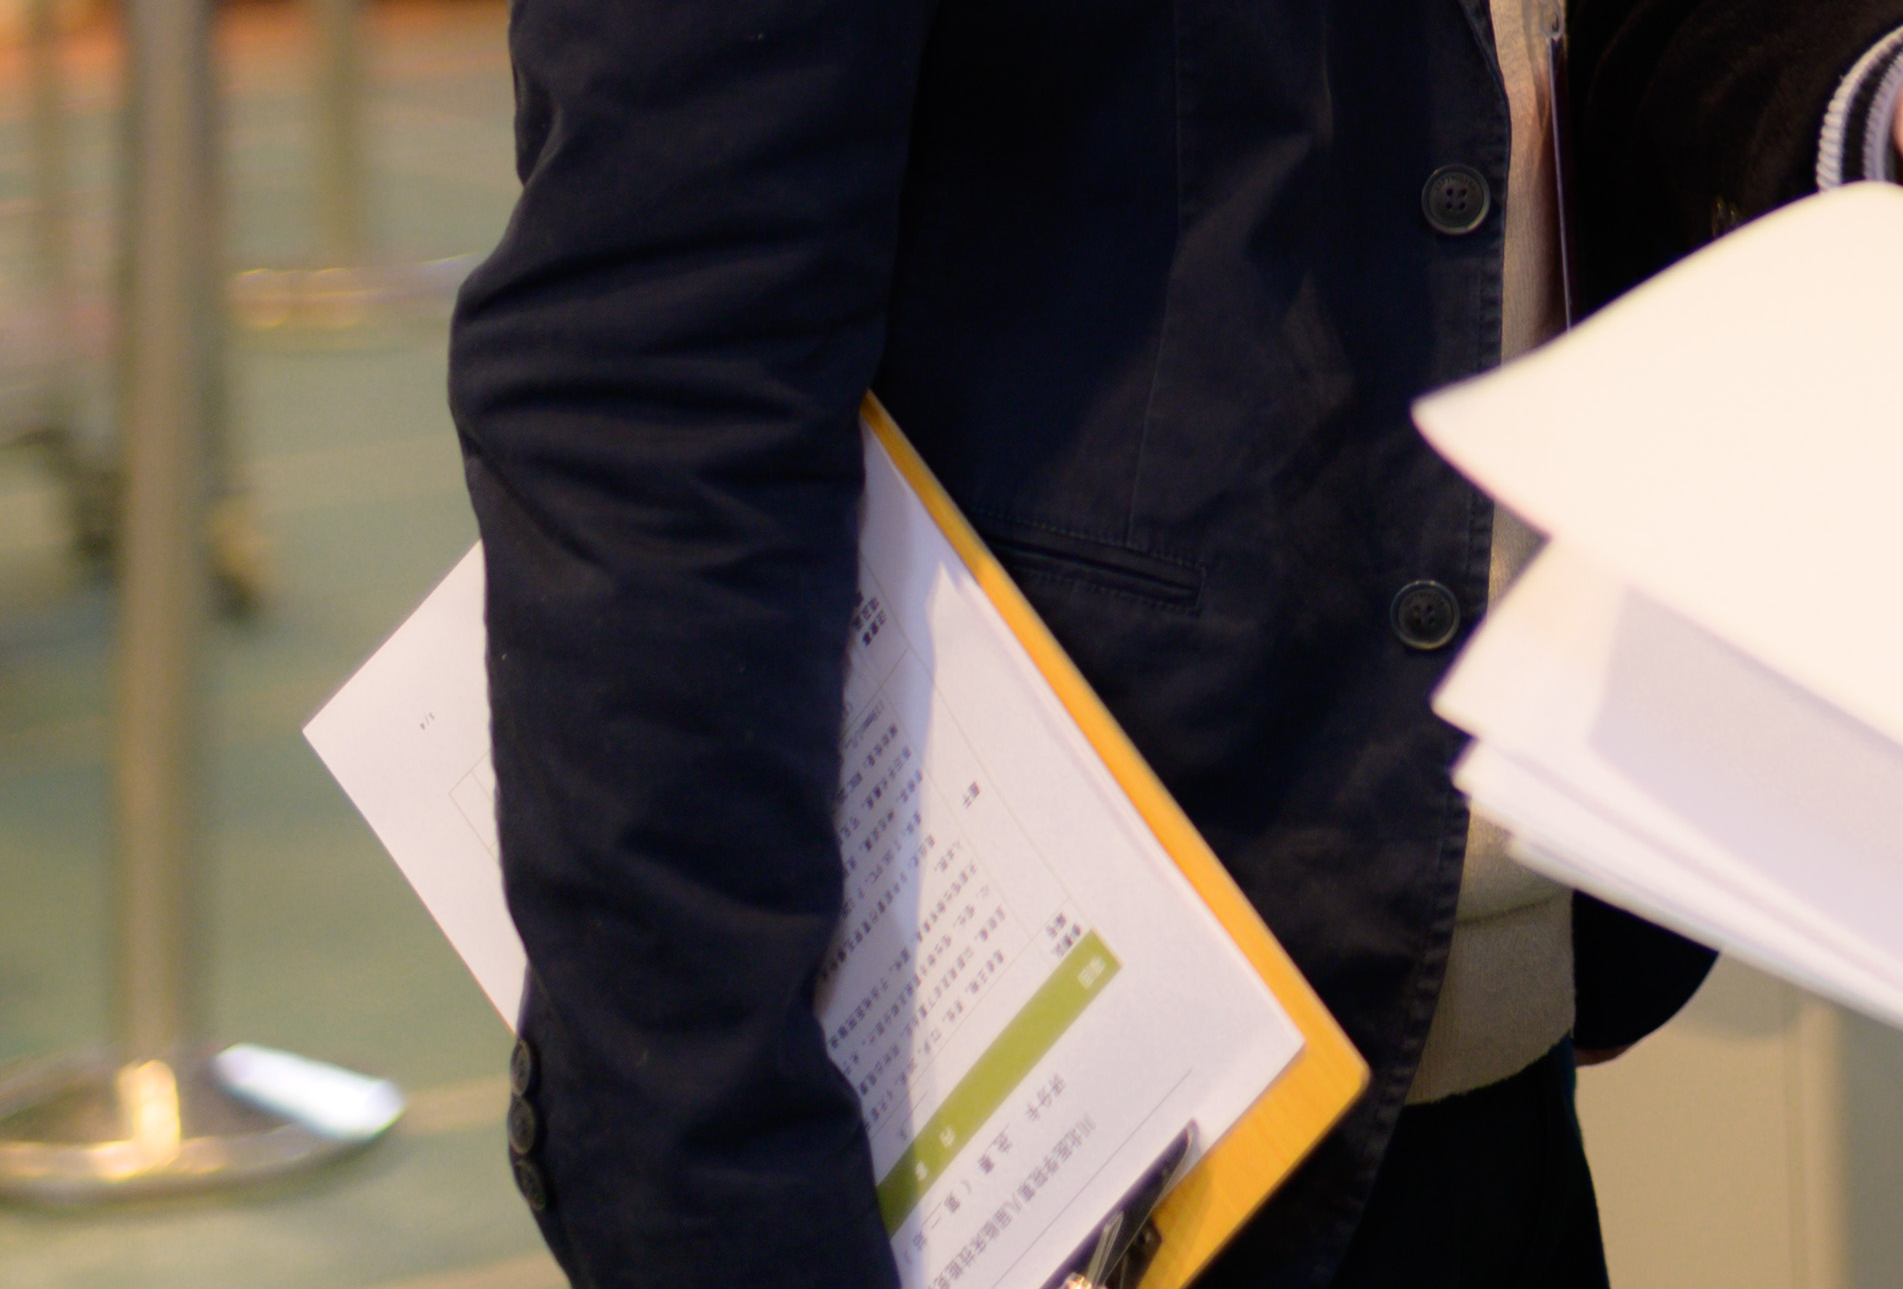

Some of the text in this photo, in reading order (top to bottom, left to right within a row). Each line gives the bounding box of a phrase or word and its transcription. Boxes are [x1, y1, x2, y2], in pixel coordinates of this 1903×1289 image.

[928, 1113, 1098, 1289] 川北医学院第八届临床技能竞
